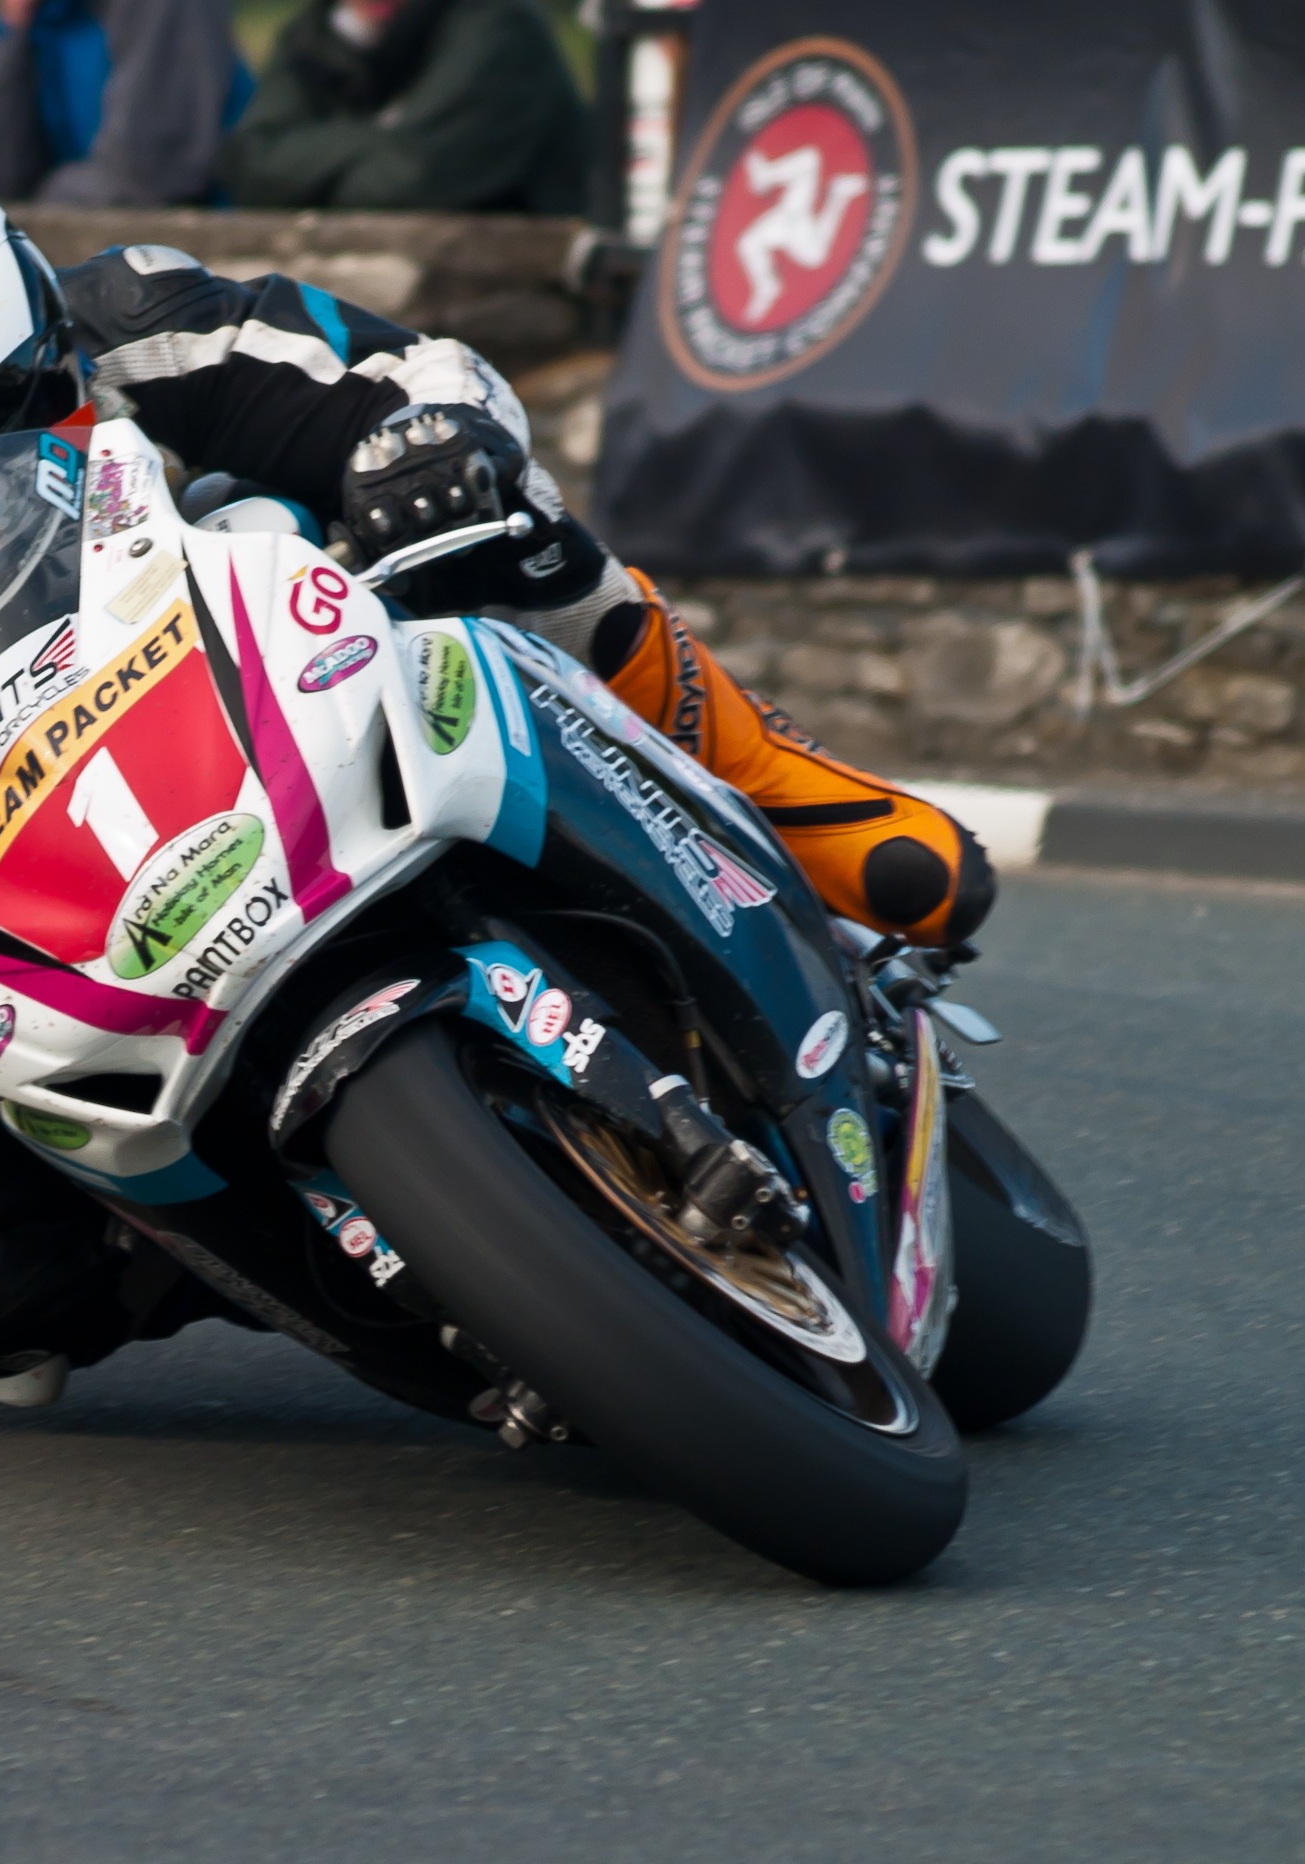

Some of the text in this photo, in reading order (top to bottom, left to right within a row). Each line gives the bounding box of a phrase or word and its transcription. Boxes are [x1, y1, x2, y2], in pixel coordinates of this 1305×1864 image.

[44, 612, 183, 758] PACKET
[67, 746, 160, 882] 1
[151, 868, 180, 896] Na
[180, 821, 232, 868] Mara
[152, 838, 244, 927] Holiday Homes
[196, 887, 210, 902] of
[210, 862, 242, 888] Man
